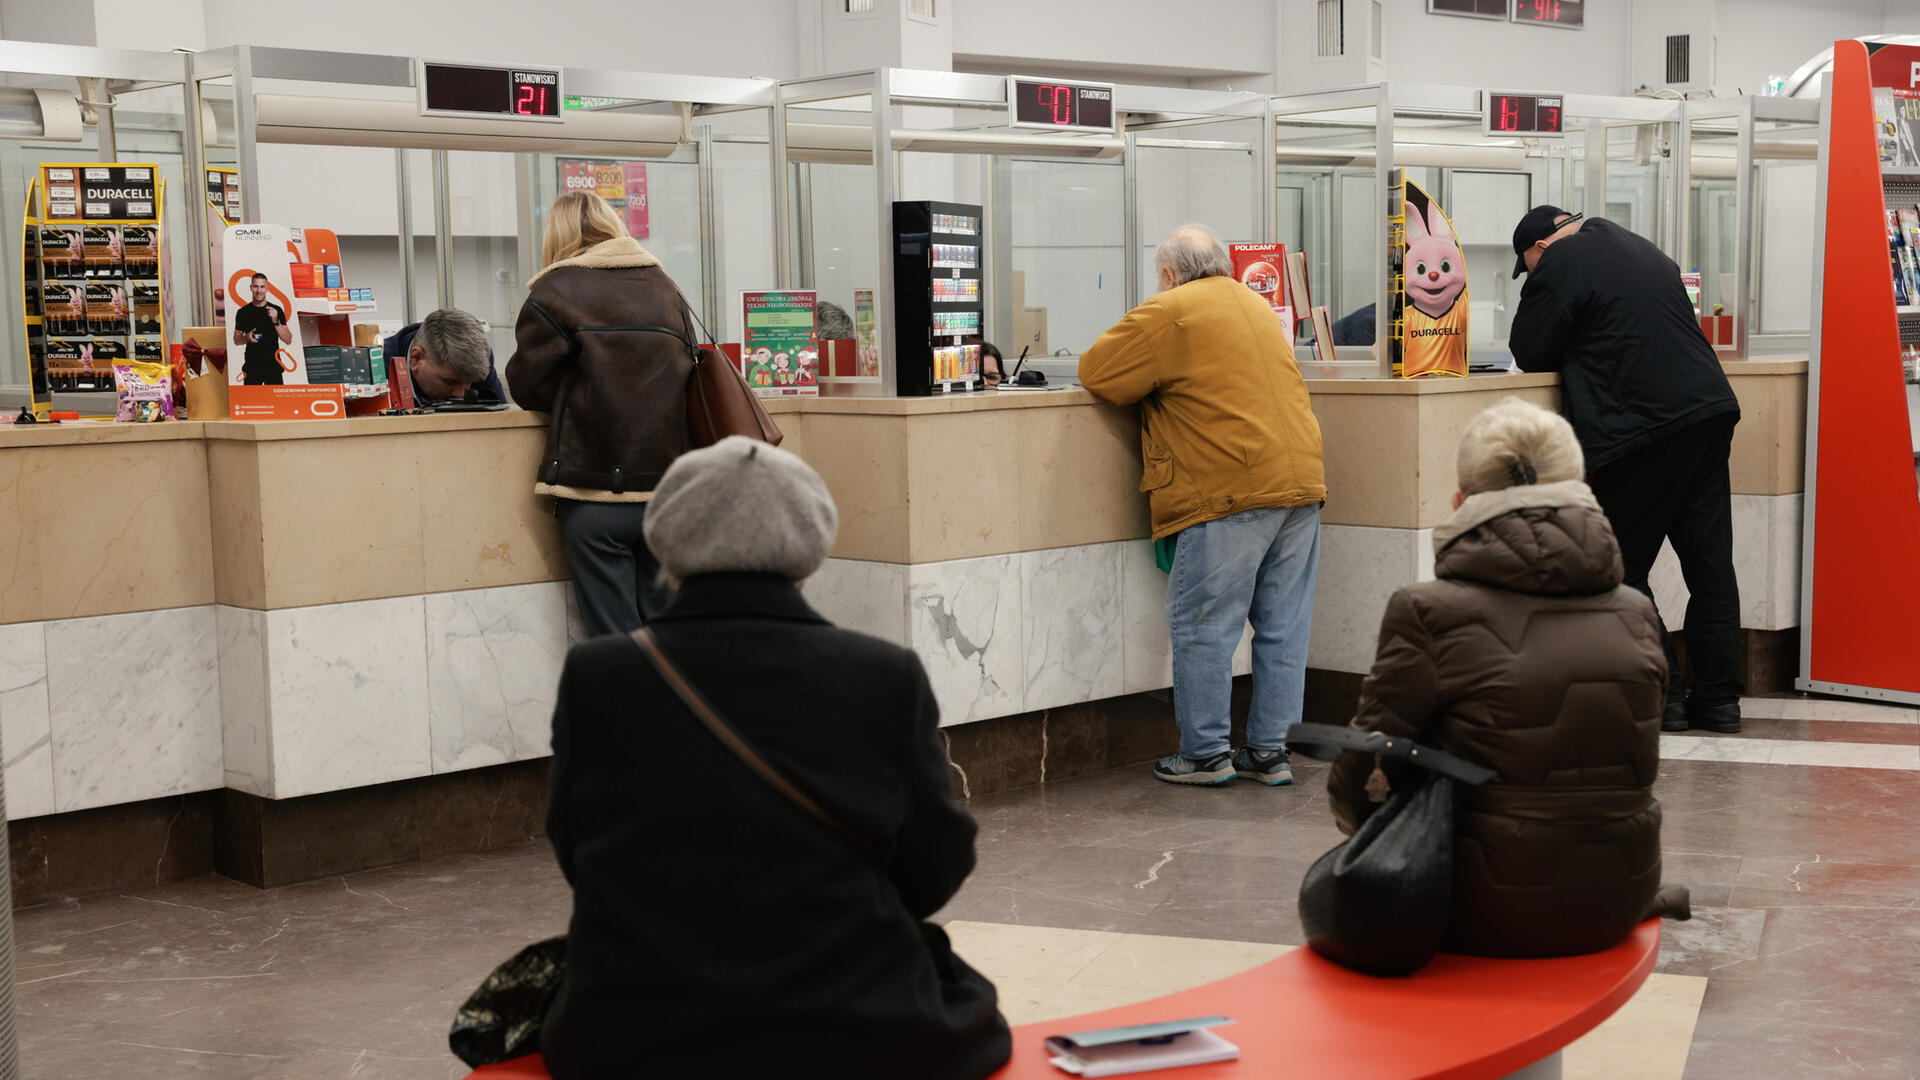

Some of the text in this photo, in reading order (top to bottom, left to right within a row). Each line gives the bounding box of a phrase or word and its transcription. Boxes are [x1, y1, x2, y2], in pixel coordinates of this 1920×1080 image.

[514, 72, 556, 84] STANOWISKO
[518, 86, 545, 115] 21
[1080, 90, 1110, 100] STANOWISKO
[566, 176, 596, 188] 6900
[596, 171, 624, 184] 8200
[87, 188, 152, 199] DURACELL
[1410, 328, 1460, 338] DURACELL
